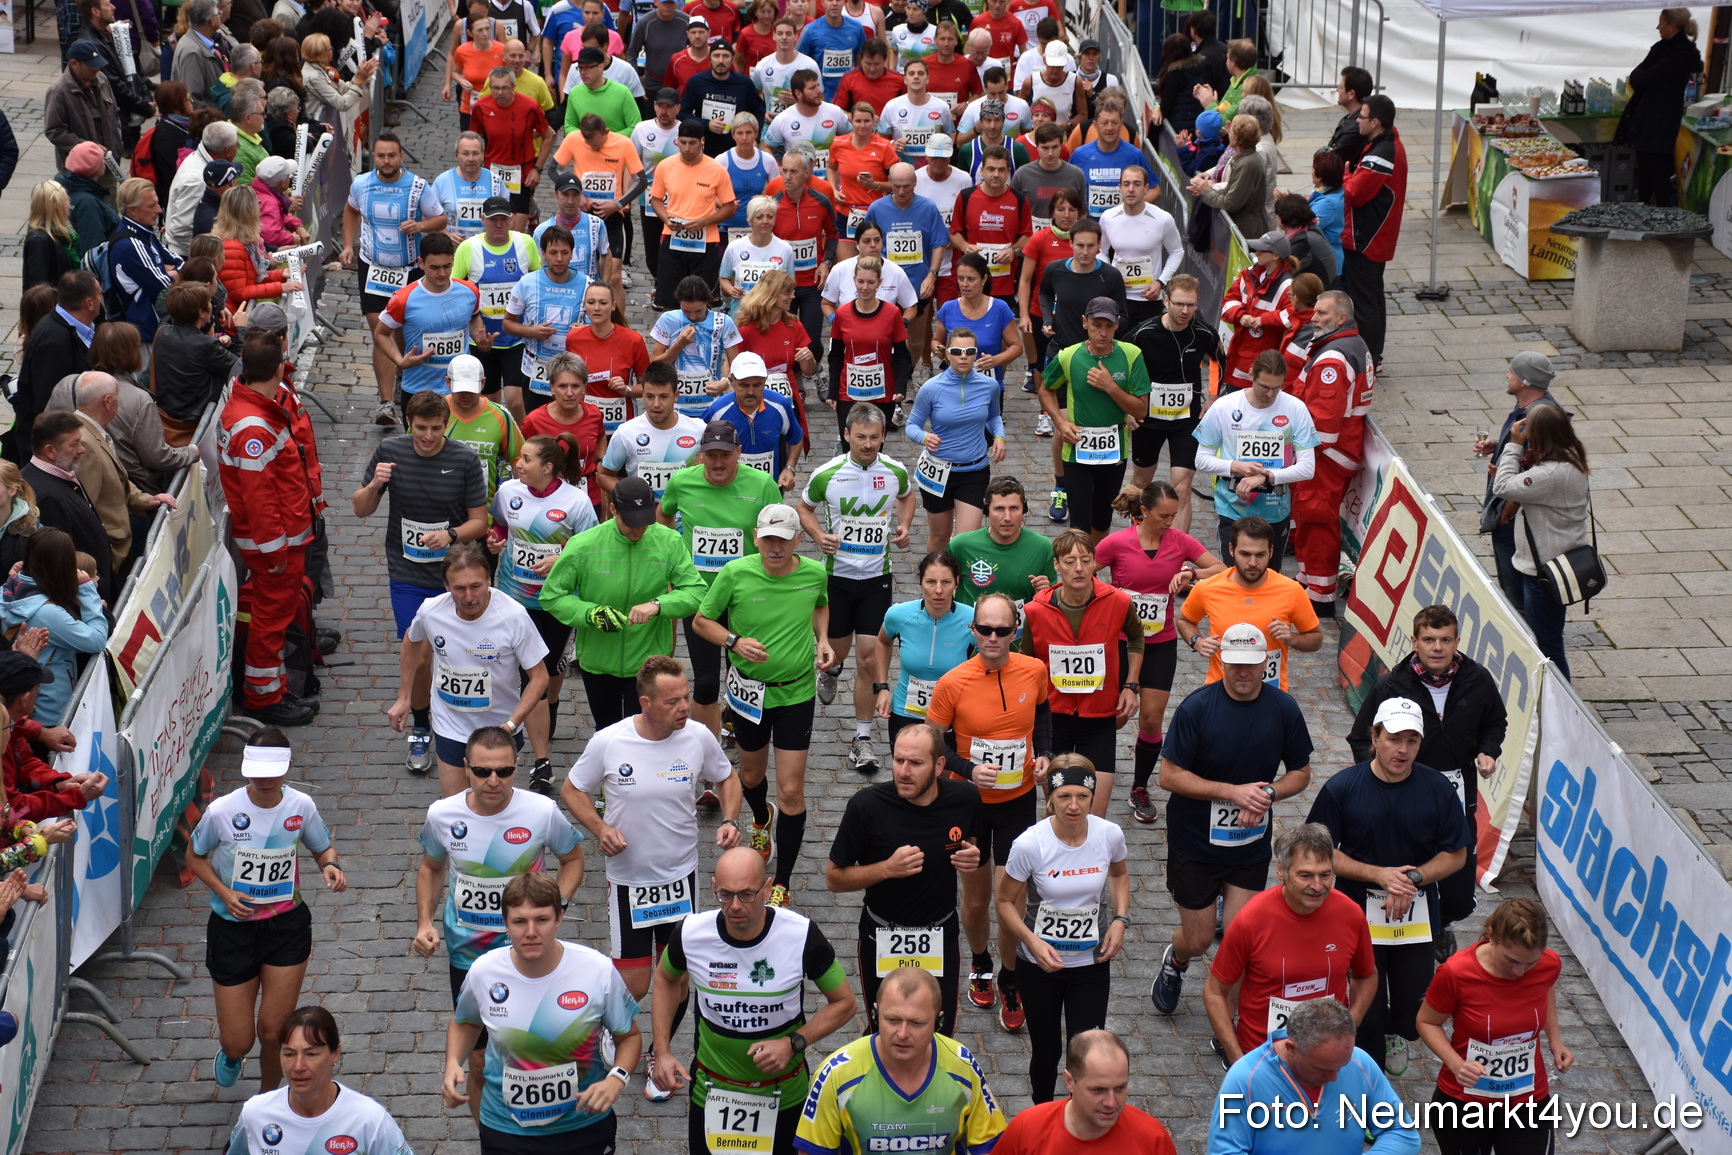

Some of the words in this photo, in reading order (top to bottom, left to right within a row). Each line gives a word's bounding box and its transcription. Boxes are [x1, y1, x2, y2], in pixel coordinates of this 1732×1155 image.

[827, 57, 851, 67] 2365
[1089, 168, 1121, 178] HUBER
[585, 178, 613, 192] 2587
[1092, 193, 1120, 205] 2545
[461, 206, 483, 218] 211
[680, 241, 697, 249] Patrick
[792, 245, 814, 259] 107
[894, 239, 917, 252] 320
[1545, 237, 1578, 258] Neumar
[1529, 244, 1576, 273] Lammsb
[371, 269, 404, 285] 2662
[743, 269, 761, 283] 264
[1126, 265, 1141, 277] 26
[545, 286, 577, 295] VIERTL
[677, 377, 707, 395] 2575
[850, 371, 881, 388] 2555
[1159, 392, 1185, 407] 139
[602, 404, 623, 421] 558
[1081, 435, 1116, 450] 2468
[1241, 440, 1281, 457] 2692
[1089, 452, 1107, 460] Albert
[918, 456, 944, 483] 2291
[643, 472, 671, 488] 311
[402, 521, 418, 531] PARTL
[419, 525, 443, 533] Neumarkt
[842, 518, 857, 526] PARTL
[857, 520, 882, 528] Neumarkt
[844, 526, 883, 544] 2188
[514, 541, 530, 550] PARTL
[697, 537, 739, 555] 2743
[846, 544, 877, 557] Reinhard
[416, 550, 435, 558] Peter
[517, 549, 543, 568] 281
[1132, 602, 1158, 620] 83
[438, 664, 452, 676] PARTL
[1061, 656, 1095, 675] 120
[440, 674, 486, 696] 2674
[1061, 678, 1095, 687] Roswitha
[728, 674, 759, 706] 2302
[451, 697, 471, 707] Josef
[972, 740, 992, 751] PARTL
[993, 743, 1020, 751] Neumarkt
[982, 751, 1016, 770] 511
[506, 830, 528, 841] Hervis
[237, 851, 260, 859] PARTL
[261, 852, 290, 860] Neumarkt
[240, 859, 293, 882] 2182
[1062, 867, 1102, 877] KLEBL
[458, 878, 476, 887] PARTL
[249, 885, 279, 897] Natalie
[635, 879, 685, 905] 2819
[461, 889, 501, 911] 239
[643, 904, 681, 919] Sebastian
[1042, 916, 1093, 939] 2522
[1393, 927, 1405, 938] Uli
[890, 934, 931, 954] 258
[899, 959, 921, 968] PuTo
[709, 981, 737, 990] OBI
[1296, 982, 1317, 994] DEHN
[560, 994, 586, 1006] Hervis
[705, 997, 784, 1014] Laufteam
[1271, 1002, 1293, 1012] PARTL
[489, 1006, 509, 1014] PARTL
[722, 1015, 769, 1029] Fürth
[1470, 1043, 1493, 1057] PARTL
[1495, 1044, 1527, 1057] Neumarkt
[1474, 1052, 1530, 1078] 2205
[504, 1072, 528, 1082] PARTL
[528, 1071, 565, 1082] Neumarkt
[510, 1079, 572, 1106] 2660
[803, 1050, 852, 1122] BOCK
[1488, 1081, 1515, 1091] Sarah
[707, 1094, 730, 1105] PARTL
[731, 1098, 766, 1108] Neumarkt
[520, 1106, 562, 1120] Clemens
[718, 1106, 761, 1133] 121
[871, 1123, 907, 1131] TEAM
[329, 1139, 356, 1151] Hervis
[716, 1137, 758, 1149] Bernhard
[869, 1134, 949, 1152] BOCK
